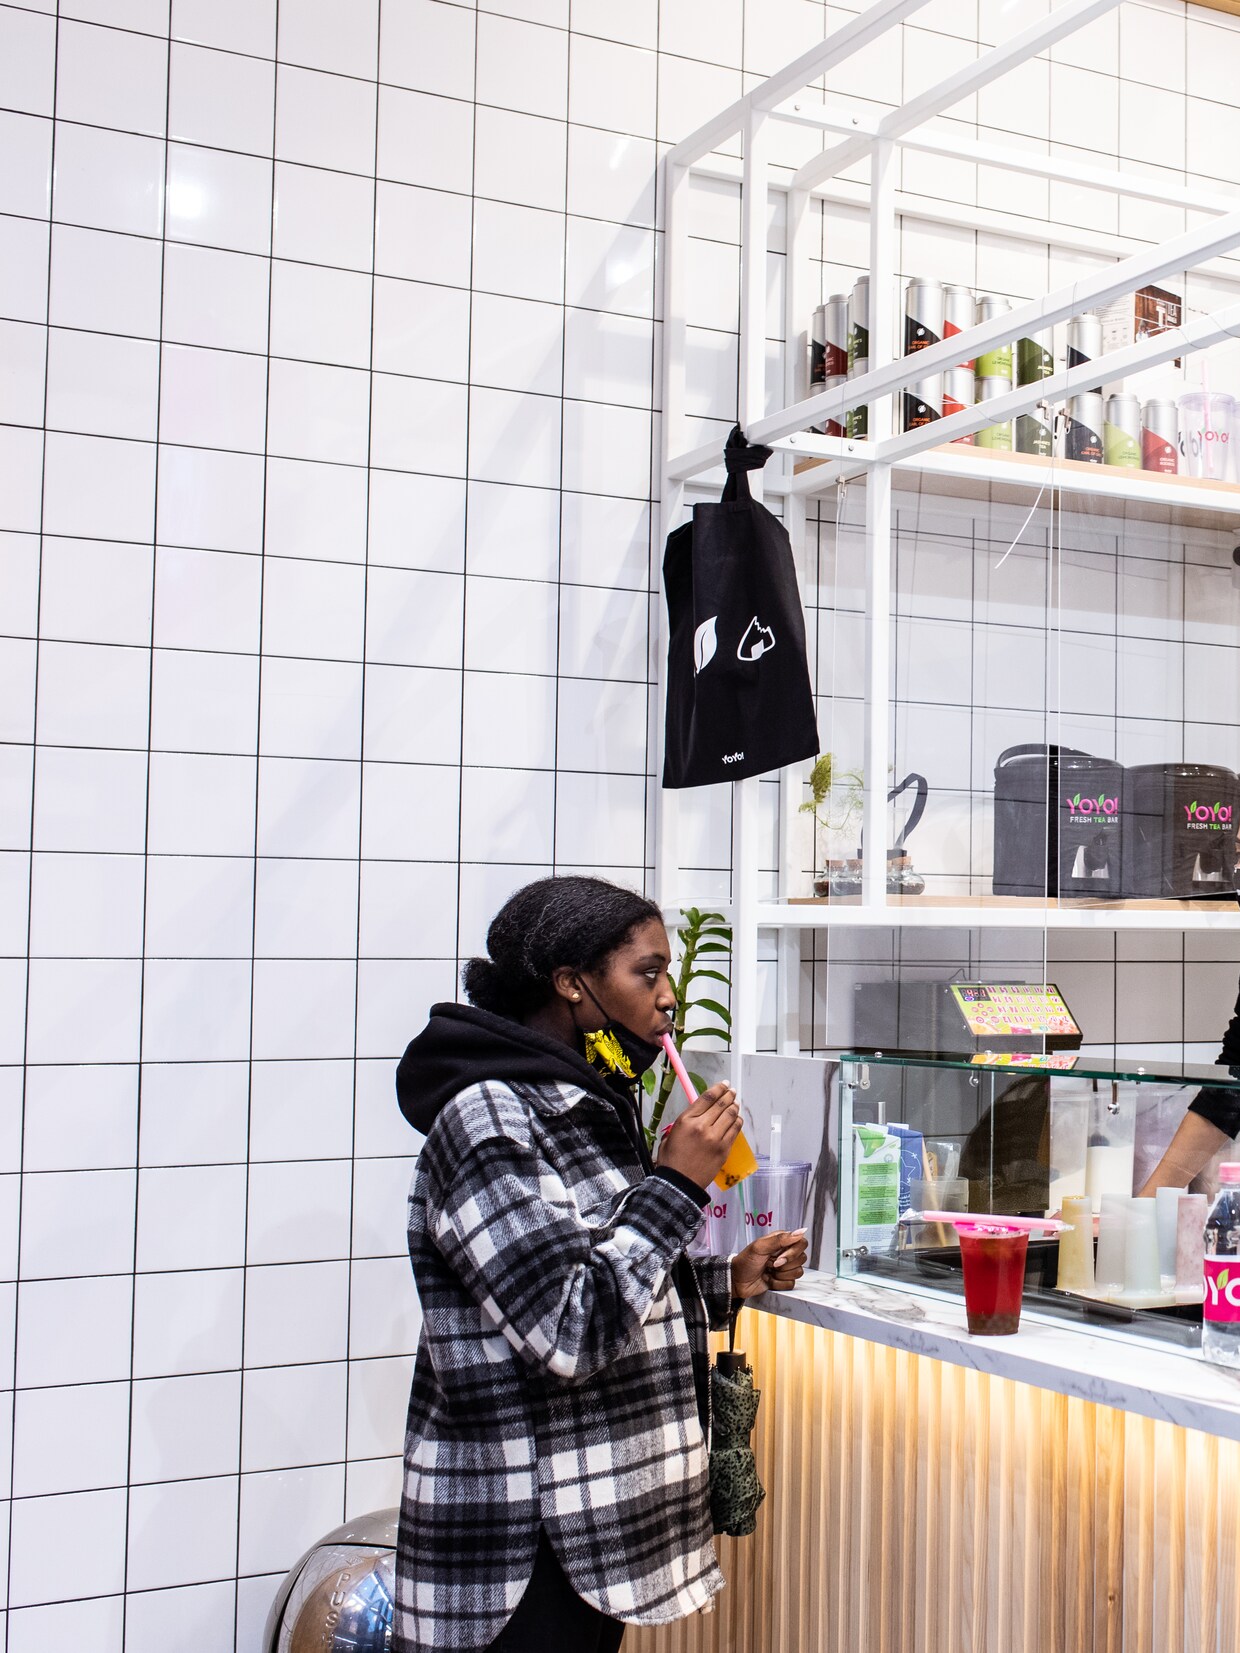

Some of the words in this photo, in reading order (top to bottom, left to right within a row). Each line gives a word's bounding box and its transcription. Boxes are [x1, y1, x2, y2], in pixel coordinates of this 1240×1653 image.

[1066, 793, 1119, 816] YOYO!
[1183, 801, 1232, 822] YOYO!
[1070, 816, 1092, 824] FRESH
[1093, 816, 1106, 824] TEA
[1107, 816, 1119, 824] BAR
